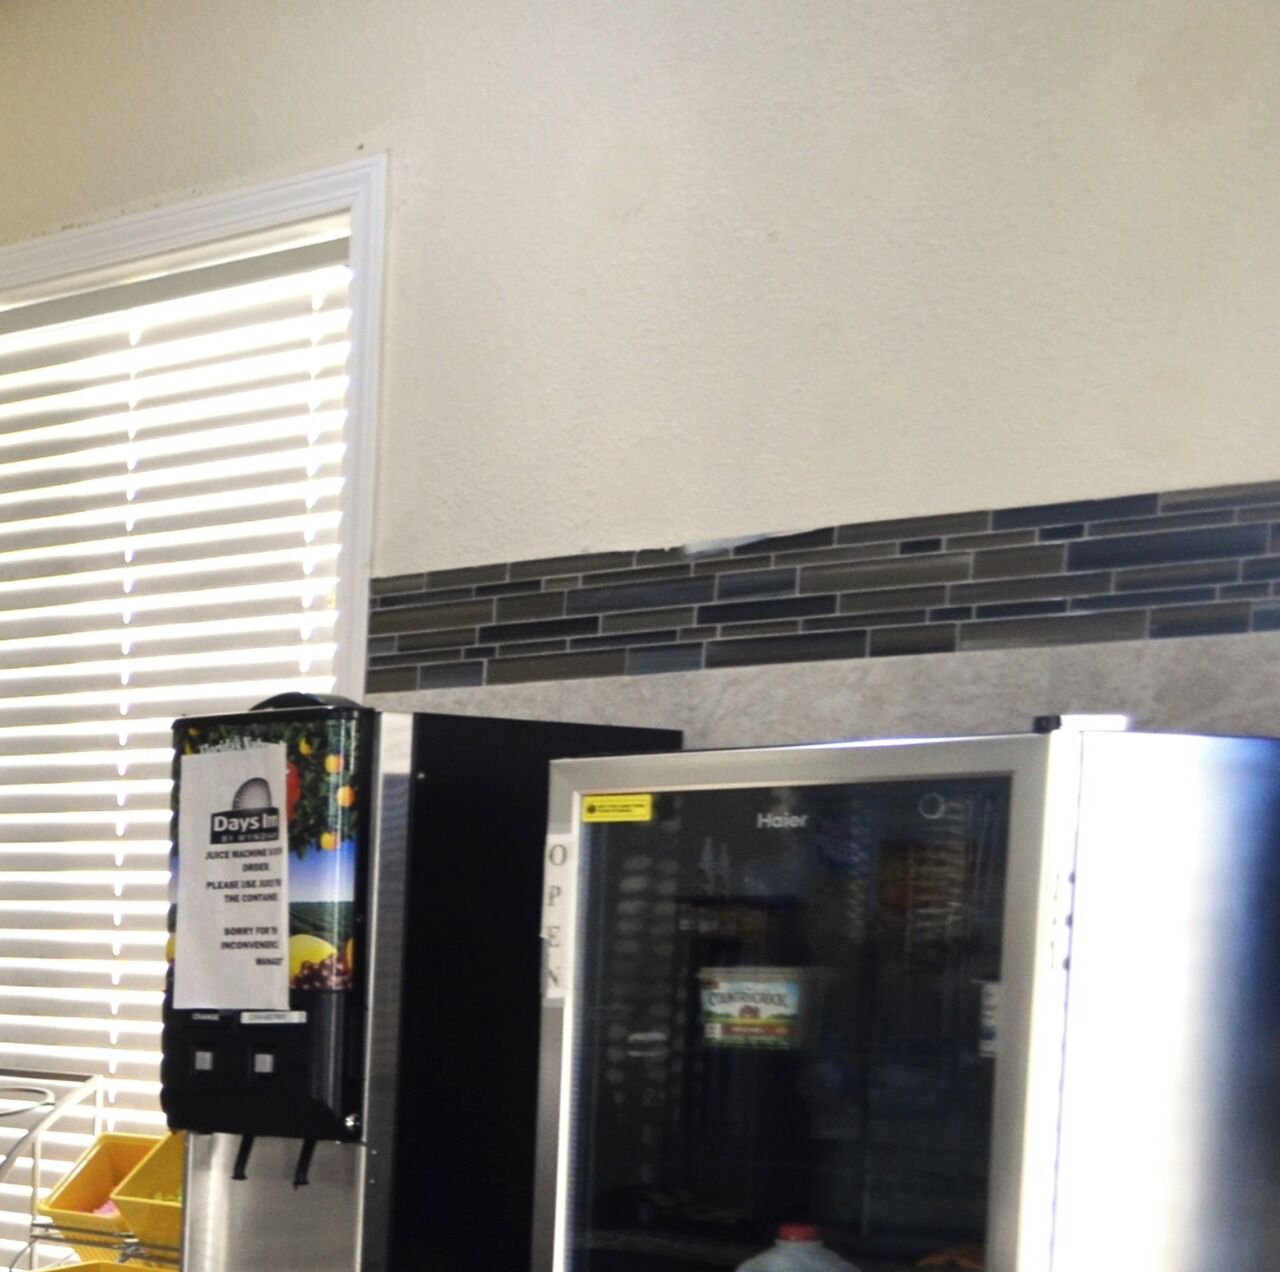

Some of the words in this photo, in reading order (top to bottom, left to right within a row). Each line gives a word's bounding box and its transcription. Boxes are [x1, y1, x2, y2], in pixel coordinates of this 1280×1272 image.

[213, 815, 260, 832] Days
[757, 813, 808, 829] Haier
[205, 850, 229, 860] JUICE
[232, 848, 267, 858] MACHINE
[206, 880, 239, 890] PLEASE
[241, 879, 256, 889] USE
[224, 894, 239, 903] THE
[224, 927, 253, 936] SORRY
